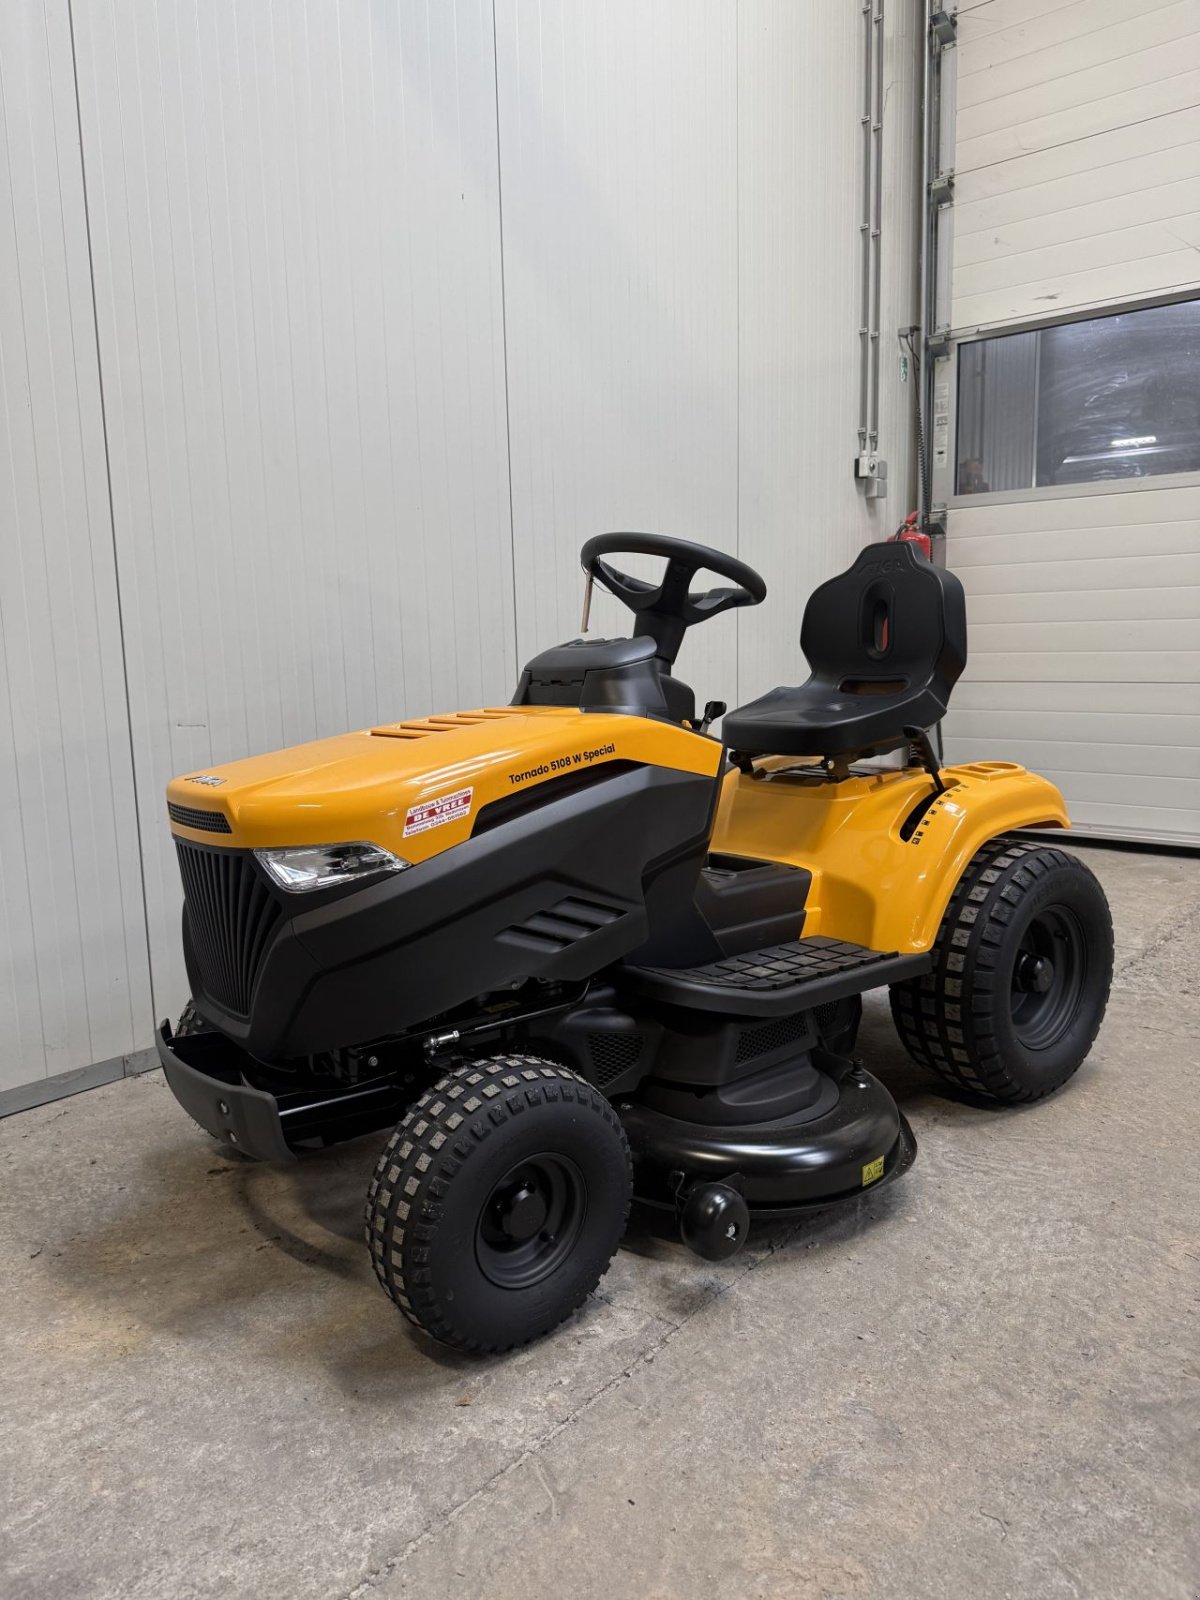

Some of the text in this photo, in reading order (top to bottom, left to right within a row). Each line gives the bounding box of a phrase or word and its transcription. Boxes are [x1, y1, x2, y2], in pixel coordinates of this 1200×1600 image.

[509, 743, 615, 784] Tornado 5108 W Special
[413, 811, 430, 822] DE
[434, 799, 464, 814] VREE
